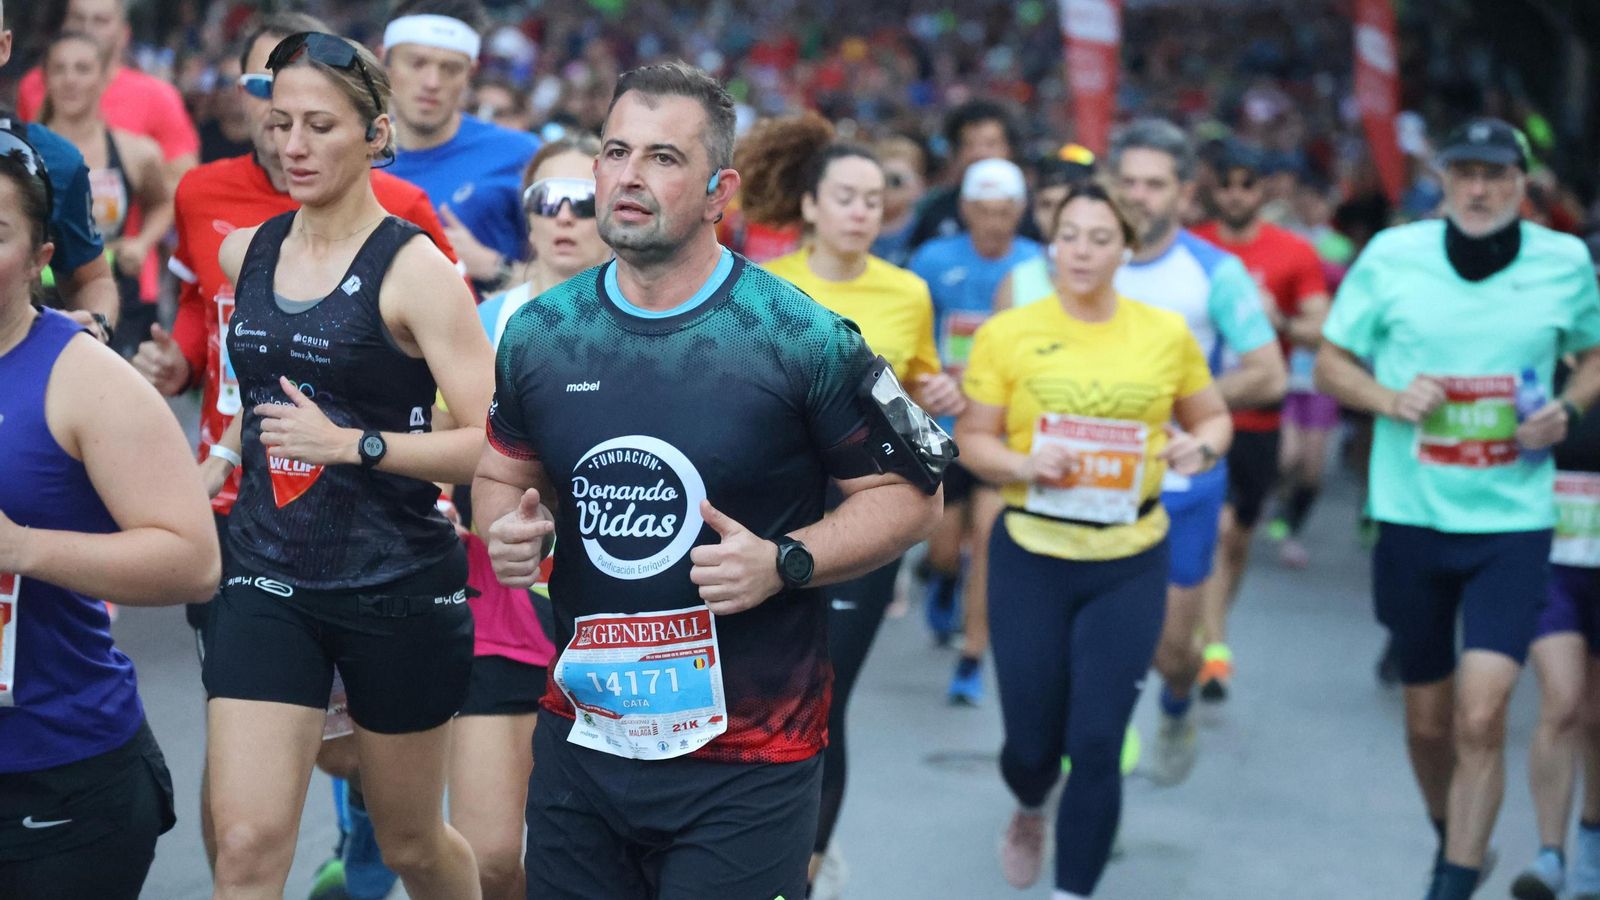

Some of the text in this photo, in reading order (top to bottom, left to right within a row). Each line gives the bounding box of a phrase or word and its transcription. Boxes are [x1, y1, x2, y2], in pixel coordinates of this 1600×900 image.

[302, 335, 329, 347] CRUIN
[566, 381, 600, 392] mobel
[592, 449, 659, 471] FUNDACIÓN
[571, 476, 678, 501] Donando
[577, 500, 677, 538] Vidas
[597, 554, 636, 575] Purificación
[587, 668, 679, 696] 14171
[623, 699, 650, 708] CATA
[672, 720, 700, 733] 21K
